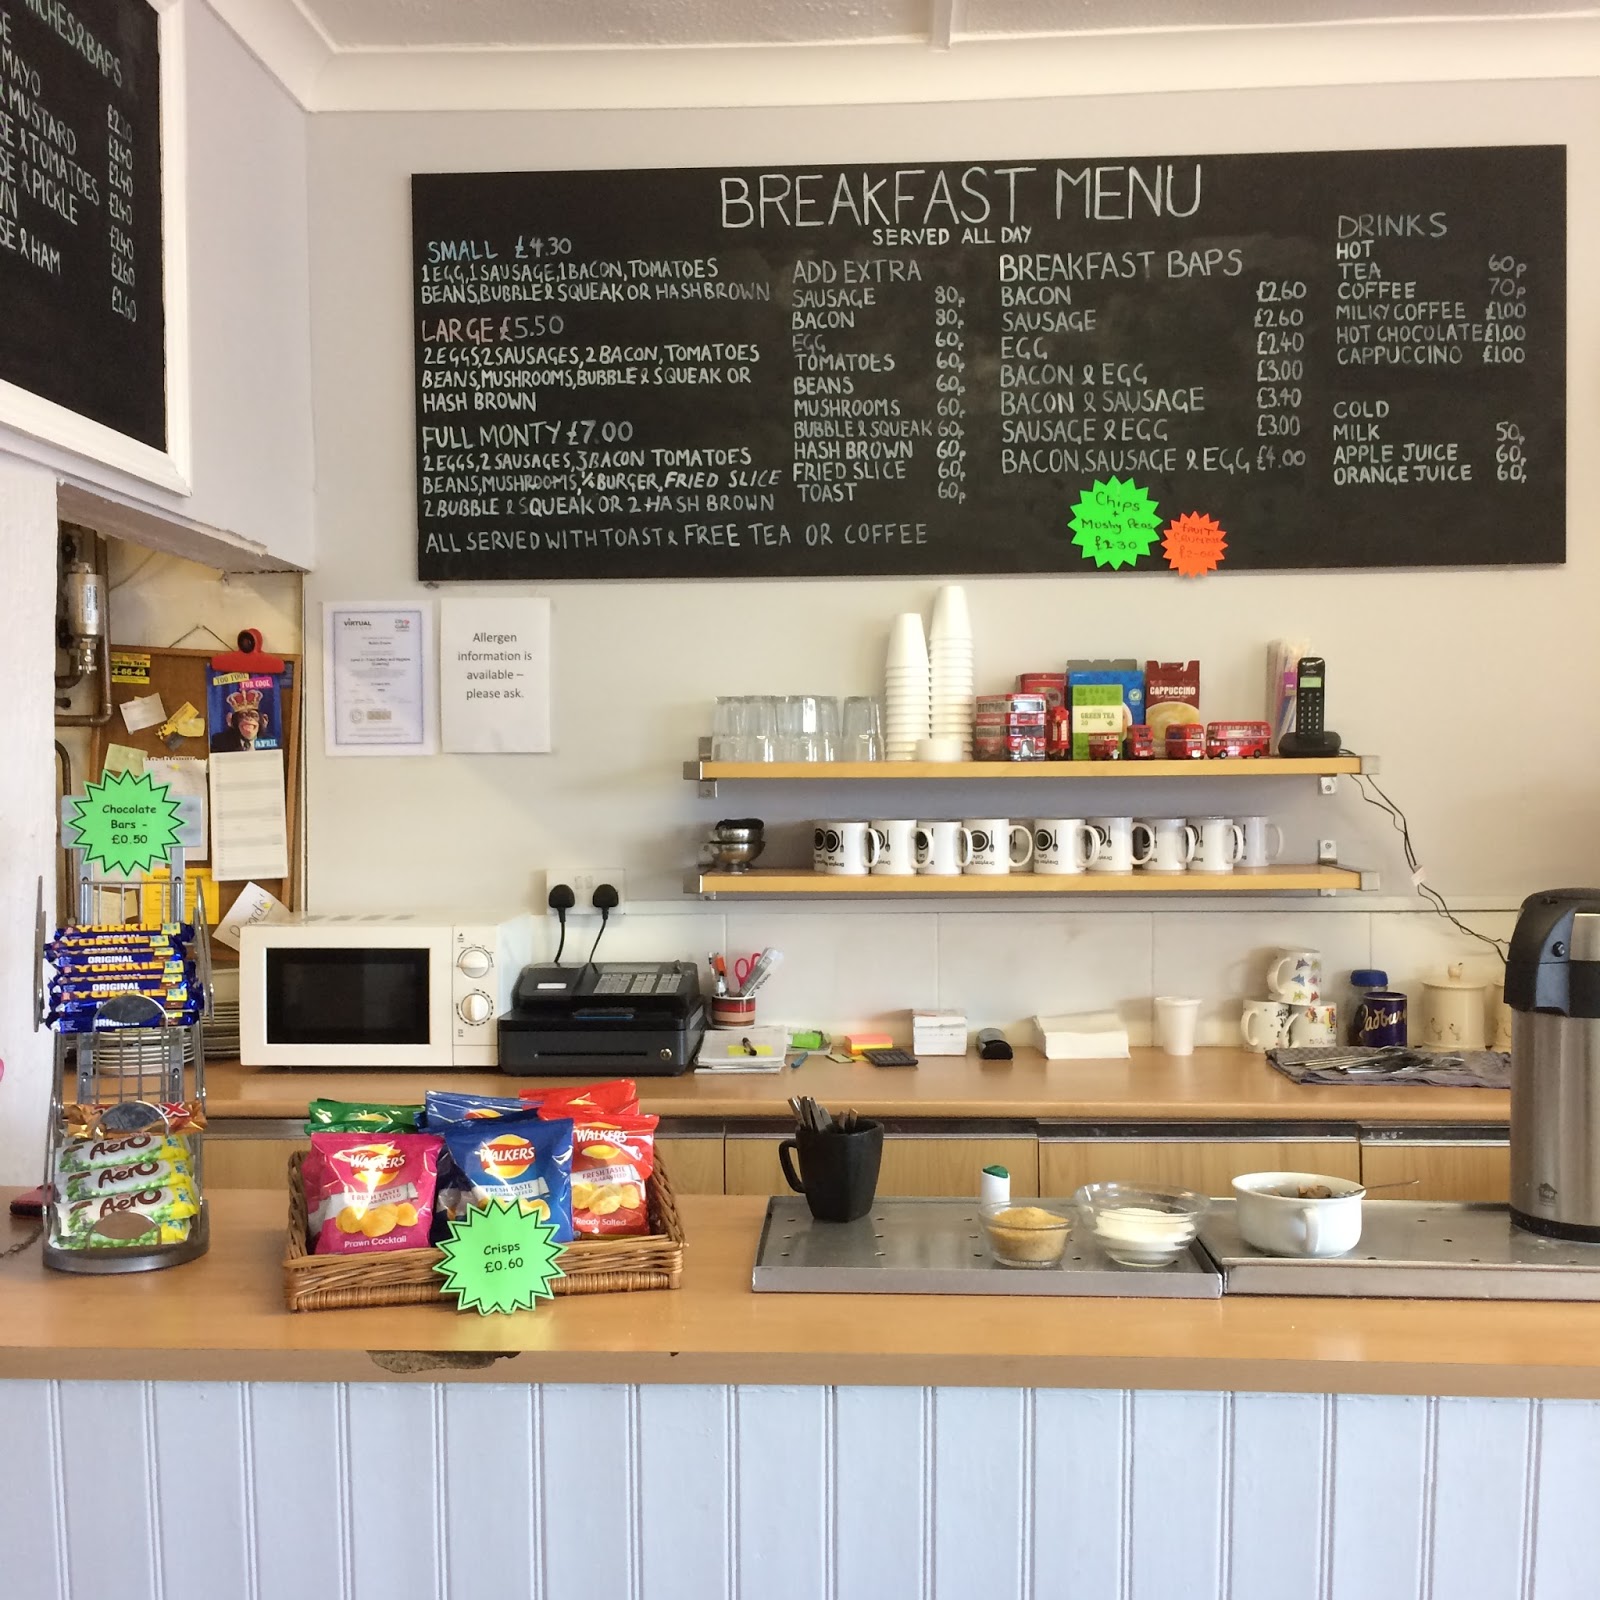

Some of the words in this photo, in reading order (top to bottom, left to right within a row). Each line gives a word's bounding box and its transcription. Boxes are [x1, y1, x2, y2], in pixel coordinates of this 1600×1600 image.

[2, 44, 41, 98] MAYO
[9, 84, 77, 156] MUSTARD
[28, 132, 100, 206] TOMATOES
[33, 168, 78, 226] PICKLE
[720, 166, 1037, 228] BREAKFAST
[1056, 163, 1201, 220] MENU
[1338, 211, 1448, 239] DRINKS
[872, 228, 950, 246] SERVED
[961, 228, 996, 244] ALL
[1001, 226, 1032, 244] DAY
[31, 235, 61, 275] HAM
[428, 240, 499, 263] SMALL
[515, 236, 572, 258] £4.30
[1336, 239, 1375, 259] HOT
[792, 259, 837, 284] ADD
[844, 259, 923, 284] EXTRA
[999, 250, 1155, 282] BREAKFAST
[1167, 248, 1243, 279] BAPS
[1338, 262, 1381, 280] TEA
[1488, 254, 1527, 278] 60p
[792, 287, 876, 309] SAUSAGE
[935, 286, 965, 307] 80p
[1001, 286, 1072, 307] BACON
[1256, 281, 1306, 303] £2.60
[1337, 281, 1416, 300] COFFEE
[1488, 277, 1526, 299] 70p
[792, 311, 855, 330] BACON
[935, 309, 964, 330] 80p
[1001, 309, 1096, 333] SAUSAGE
[1336, 303, 1390, 320] MILKY
[1394, 302, 1466, 320] COFFEE
[422, 317, 494, 346] LARGE
[500, 315, 564, 342] £5.50
[1337, 325, 1371, 344] HOT
[1377, 323, 1483, 344] CHOCOLATE
[793, 334, 826, 354] EGG
[935, 331, 964, 351] 60p
[1001, 336, 1048, 360] EGG
[794, 353, 896, 373] TOMATOES
[936, 351, 965, 373] 60p
[1337, 345, 1463, 365] CAPPUCCINO
[654, 366, 723, 385] SQUEAK
[727, 366, 751, 385] OR
[1000, 363, 1074, 388] BACON
[1082, 364, 1096, 386] &
[1102, 362, 1148, 386] EGG
[1257, 360, 1304, 383] £3.00
[794, 375, 855, 396] BEANS
[935, 374, 966, 396] 60p
[423, 391, 468, 413] HASH
[474, 391, 537, 413] BROWN
[794, 398, 901, 418] MUSHROOMS
[1001, 391, 1074, 416] BACON
[1084, 391, 1097, 413] &
[1103, 387, 1205, 413] SAUSAGE
[1256, 386, 1302, 410] £3.40
[1333, 400, 1390, 419] COLD
[423, 425, 474, 453] FULL
[480, 421, 562, 449] MONTY
[794, 420, 853, 439] BUBBLE
[870, 419, 933, 438] SQUEAK
[1002, 418, 1096, 444] SAUSAGE
[1121, 417, 1168, 442] EGG
[1257, 414, 1301, 437] £3.00
[1333, 423, 1380, 442] MILK
[651, 447, 752, 467] TOMATOES
[794, 441, 840, 460] HASH
[846, 440, 913, 459] BROWN
[936, 440, 966, 460] 60p
[1203, 447, 1250, 475] EGG
[1256, 445, 1306, 471] £4.00
[1333, 445, 1394, 465] APPLE
[1402, 443, 1458, 462] JUICE
[728, 470, 782, 488] SLICE
[793, 462, 847, 482] FRIED
[853, 460, 906, 480] SLICE
[937, 460, 966, 482] 60p
[1333, 465, 1409, 486] ORANGE
[1413, 464, 1473, 482] JUICE
[797, 482, 858, 503] TOAST
[937, 482, 966, 504] 60p
[1096, 491, 1140, 512] Chips
[437, 498, 500, 518] BUBBLE
[519, 496, 595, 518] SQUEAK
[599, 495, 623, 513] OR
[644, 494, 700, 513] HASH
[706, 493, 775, 512] BROWN
[1081, 518, 1122, 535] Mushy
[426, 529, 462, 553] ALL
[466, 529, 540, 552] SERVED
[545, 528, 597, 549] WITH
[600, 527, 663, 547] TOAST
[684, 523, 741, 547] FREE
[748, 523, 791, 546] TEA
[805, 522, 834, 546] OR
[844, 523, 928, 545] COFFEE
[472, 632, 518, 645] Allergen
[457, 651, 522, 662] information
[524, 651, 532, 662] is
[466, 669, 514, 680] available
[466, 688, 501, 701] please
[503, 687, 525, 699] ask.
[1149, 686, 1196, 696] CAPPUCCINO
[102, 804, 157, 815] Chocolate
[111, 819, 136, 830] Bars
[111, 834, 148, 845] £0.50
[63, 935, 150, 947] YORKIE
[75, 961, 164, 973] YORKIE
[87, 955, 134, 964] ORIGINAL
[92, 982, 140, 991] ORIGINAL
[480, 1147, 535, 1162] WALKERS
[601, 1218, 627, 1226] Salted
[344, 1239, 370, 1249] Prawn
[371, 1235, 407, 1246] Cocktail
[483, 1242, 521, 1258] Crisps
[484, 1257, 524, 1273] £0.60
